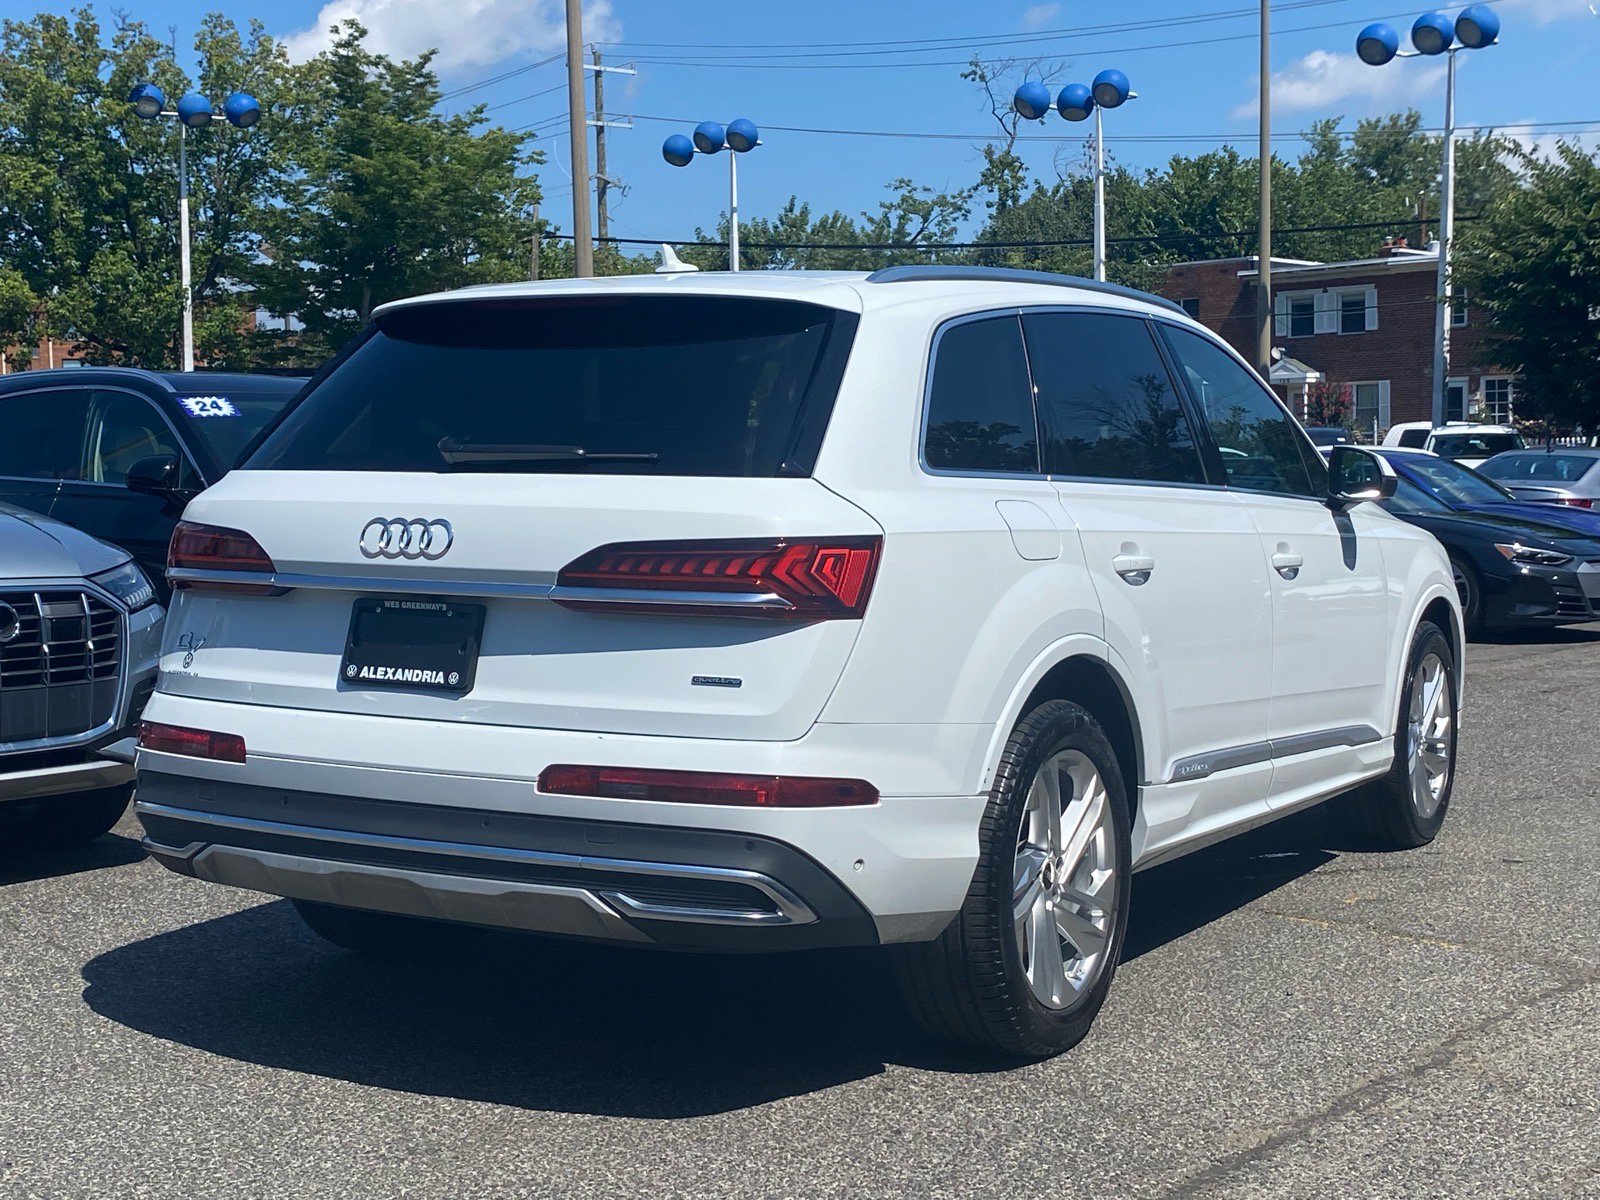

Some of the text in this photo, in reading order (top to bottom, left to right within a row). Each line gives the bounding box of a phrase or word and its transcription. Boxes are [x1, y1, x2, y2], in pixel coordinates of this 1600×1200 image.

[195, 400, 223, 411] 24
[384, 600, 447, 611] WES GREENWAY'S
[359, 665, 445, 684] ALEXANDRIA
[692, 676, 741, 686] quattro
